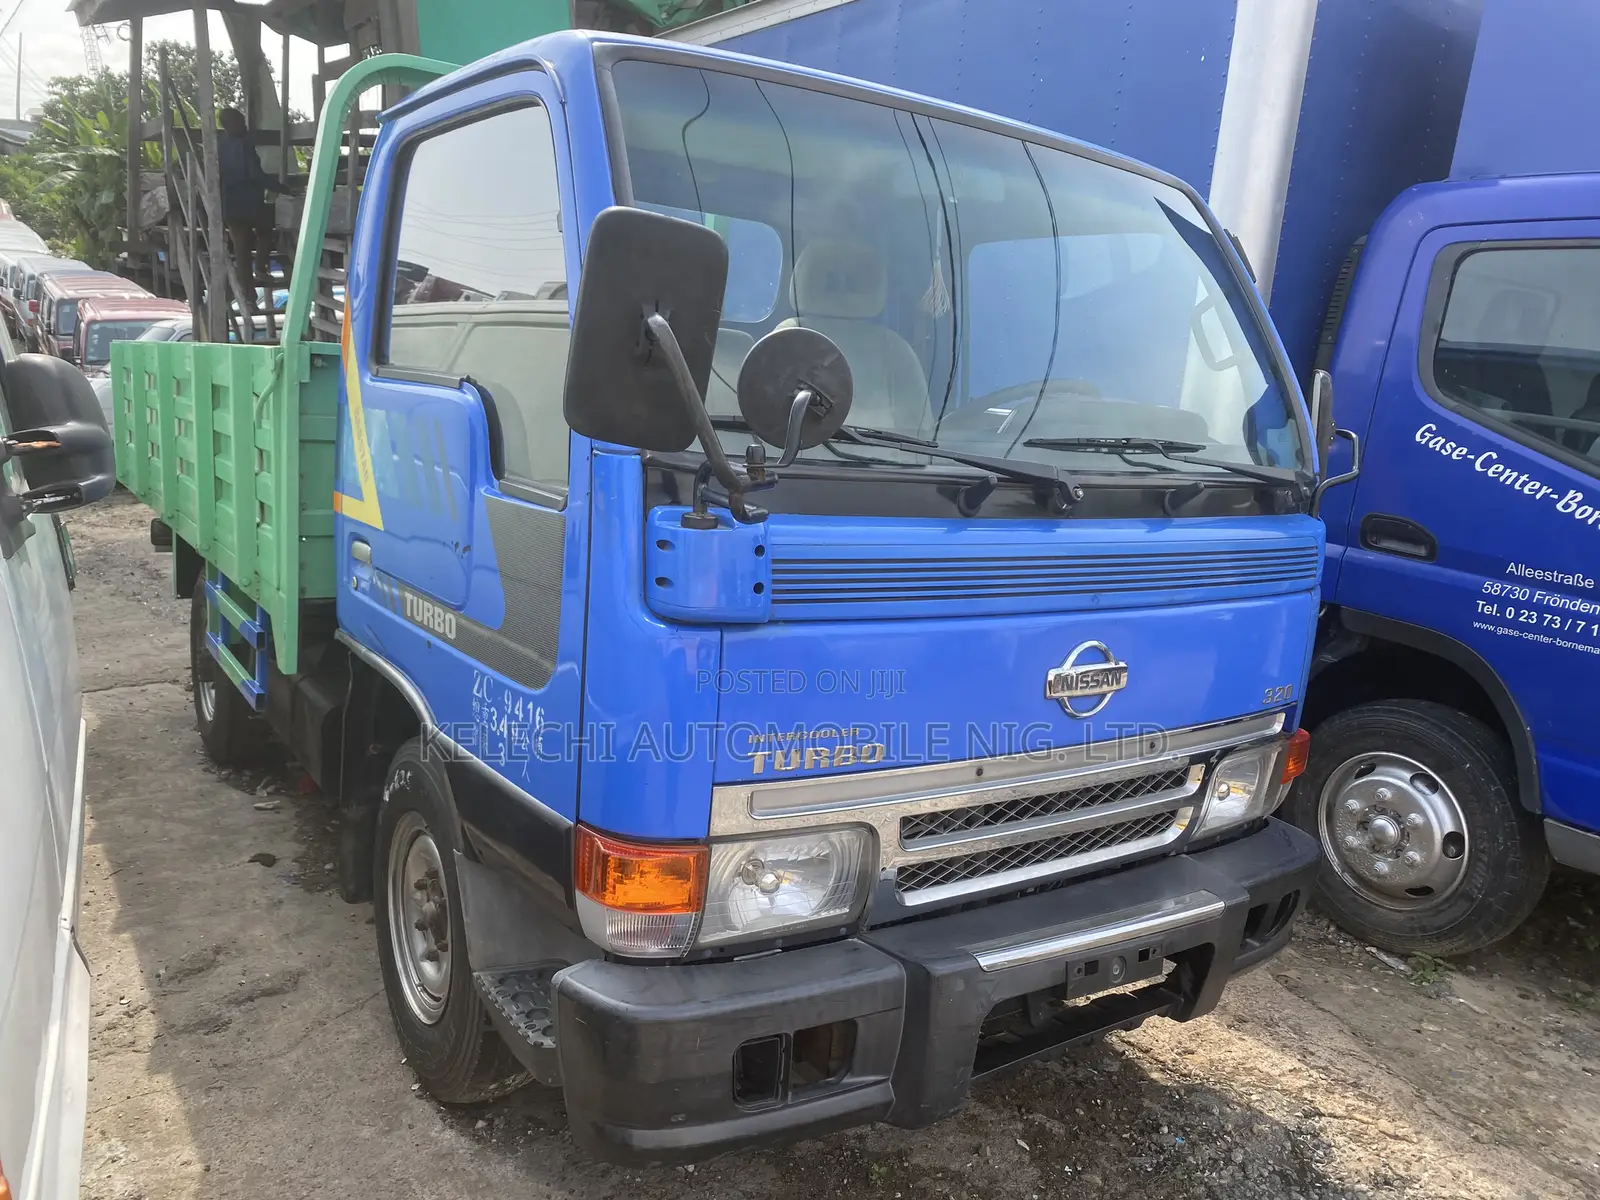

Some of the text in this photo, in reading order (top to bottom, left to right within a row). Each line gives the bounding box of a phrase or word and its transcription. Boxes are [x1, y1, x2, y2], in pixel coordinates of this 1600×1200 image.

[1415, 422, 1600, 530] Gase-Center-Bor
[1505, 562, 1594, 589] Alleestraße
[1482, 581, 1600, 615] 58730 Frönden
[404, 591, 456, 640] TURBO
[1476, 600, 1500, 617] Tel.
[1505, 606, 1515, 619] 0
[1518, 609, 1538, 624] 23
[1543, 613, 1561, 628] 73
[1576, 620, 1586, 633] 7
[1058, 667, 1124, 693] NISSAN
[1262, 684, 1294, 704] 320
[748, 727, 860, 744] INTERCOOLER
[748, 743, 885, 774] TURBO
